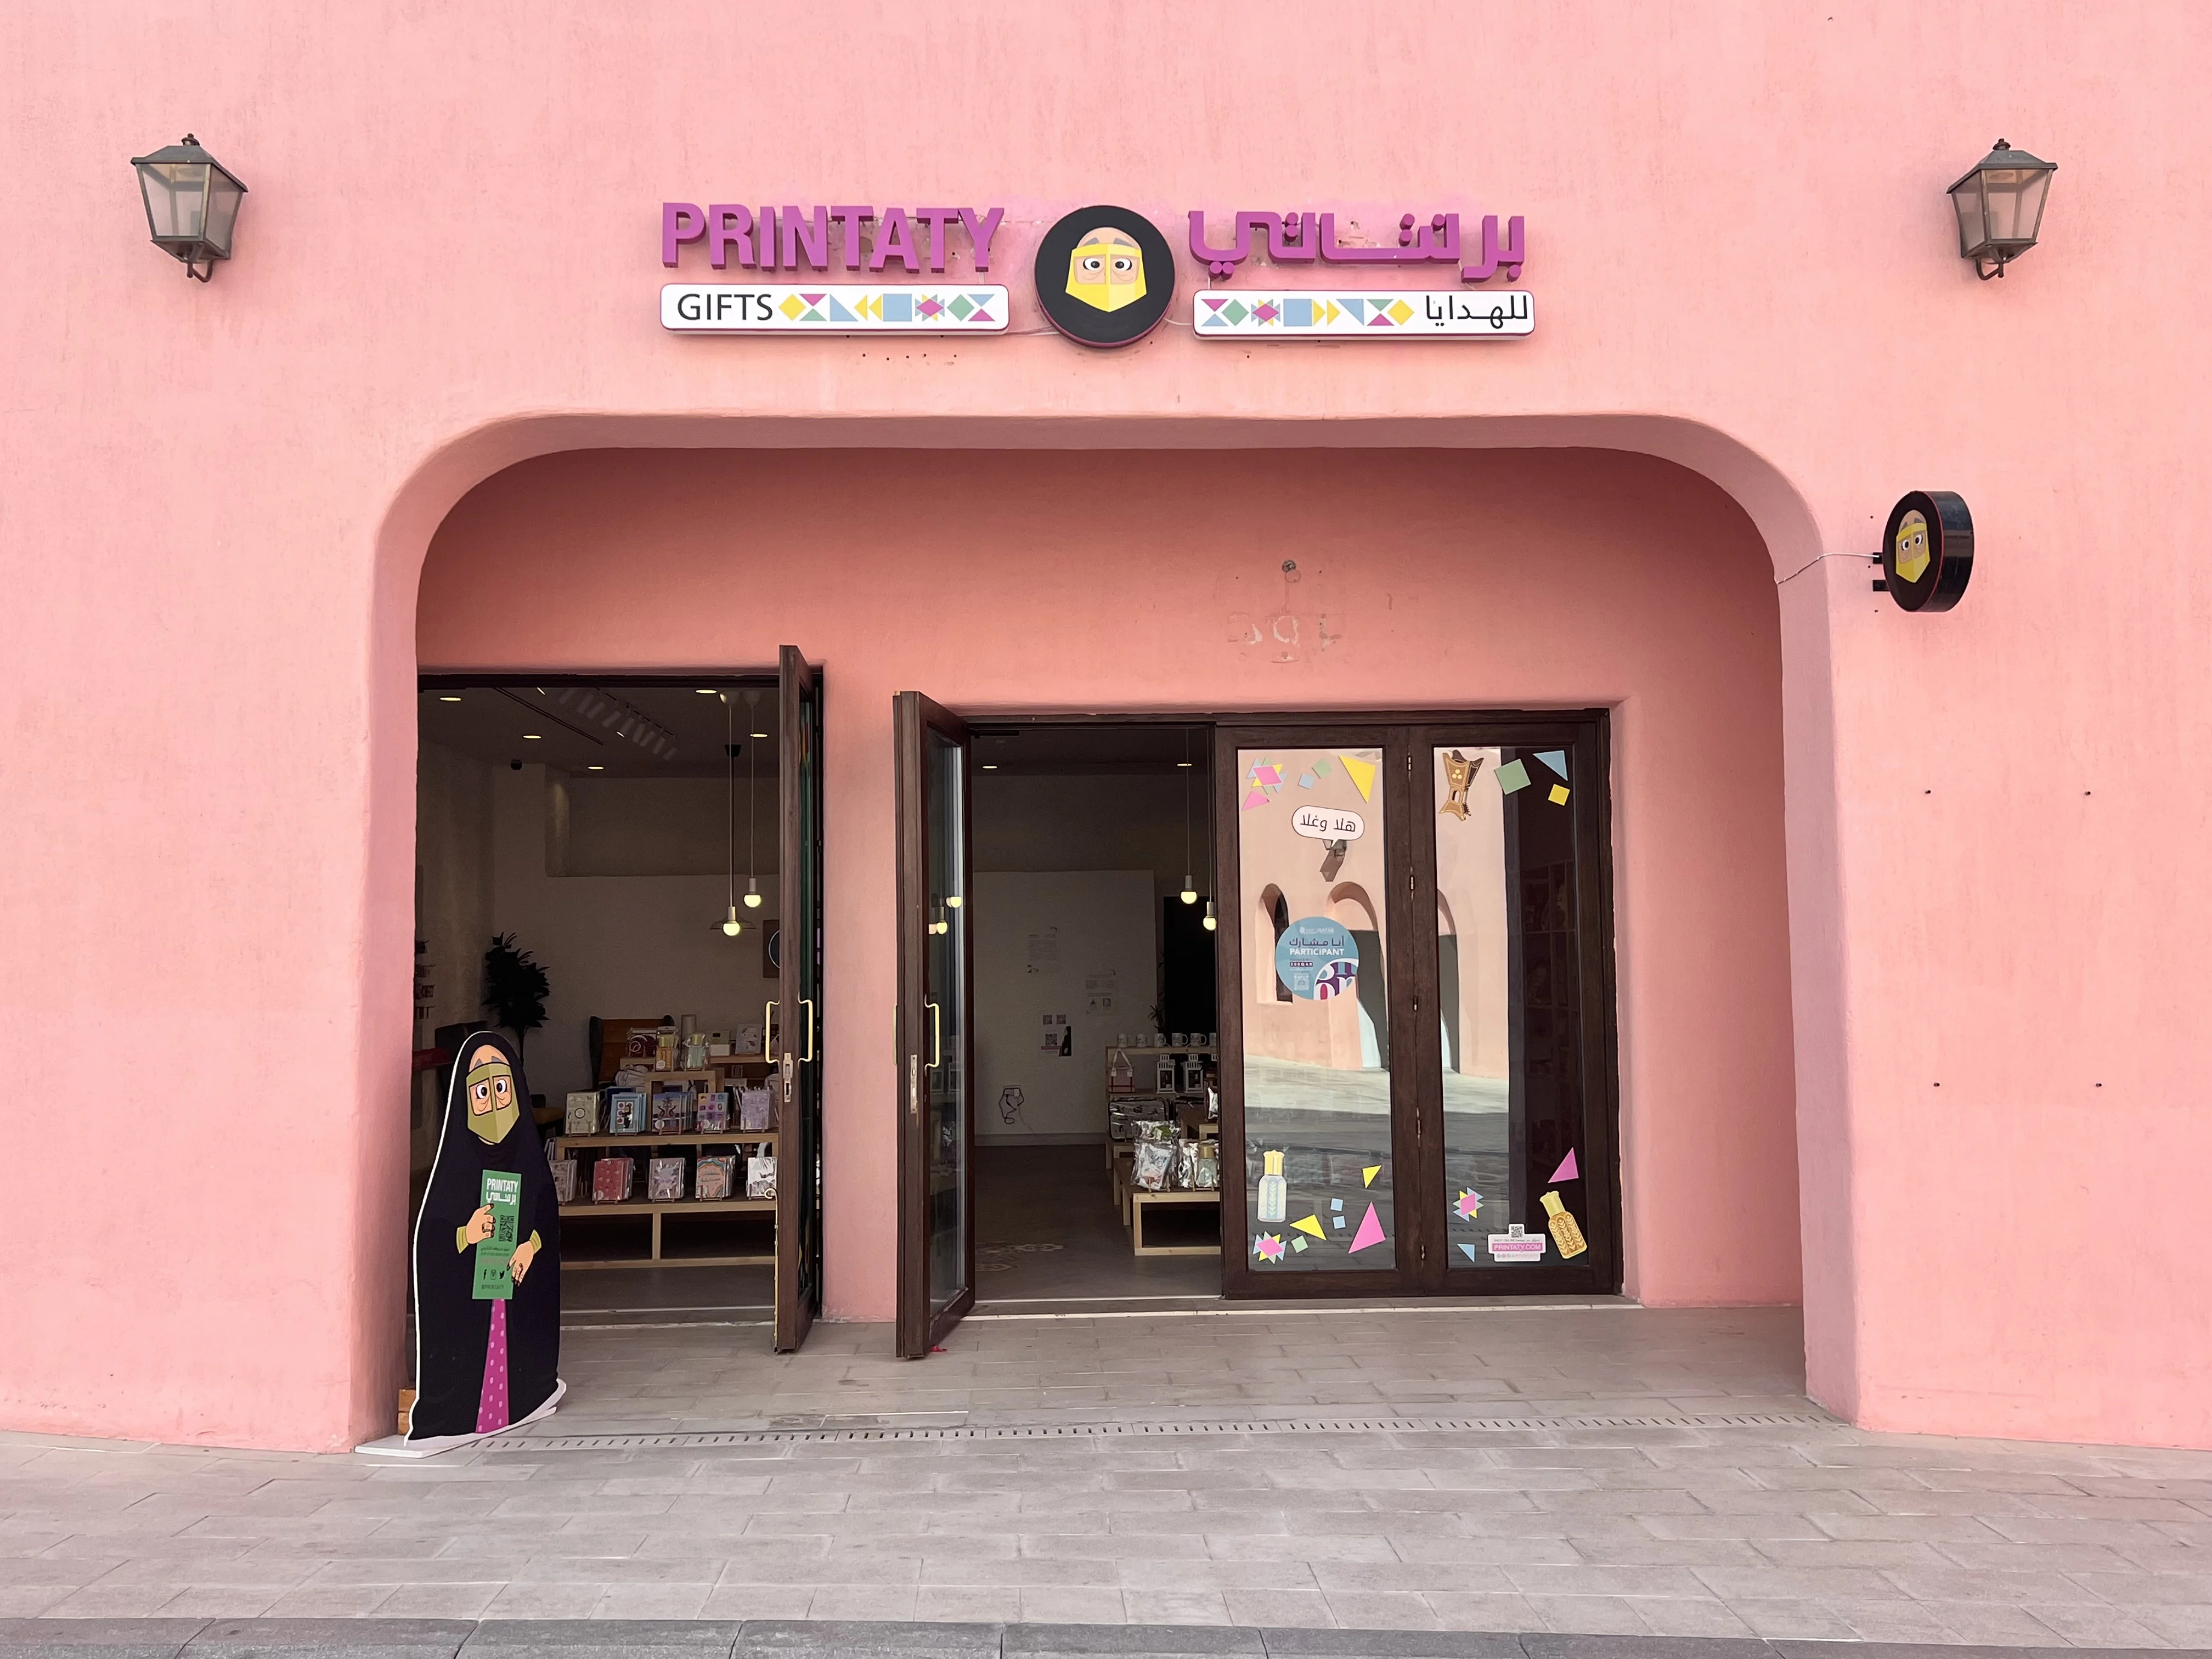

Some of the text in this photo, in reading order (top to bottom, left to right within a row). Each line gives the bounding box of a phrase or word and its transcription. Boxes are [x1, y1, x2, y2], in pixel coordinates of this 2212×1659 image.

[662, 202, 1005, 273] PRINTATY
[1188, 211, 1525, 283] برنتاتي
[677, 293, 773, 321] GIFTS
[1425, 295, 1528, 329] للهدايا
[1300, 813, 1356, 832] هلا وغلا
[1289, 935, 1345, 948] أنا مشارك
[486, 1178, 519, 1193] PRINTATY
